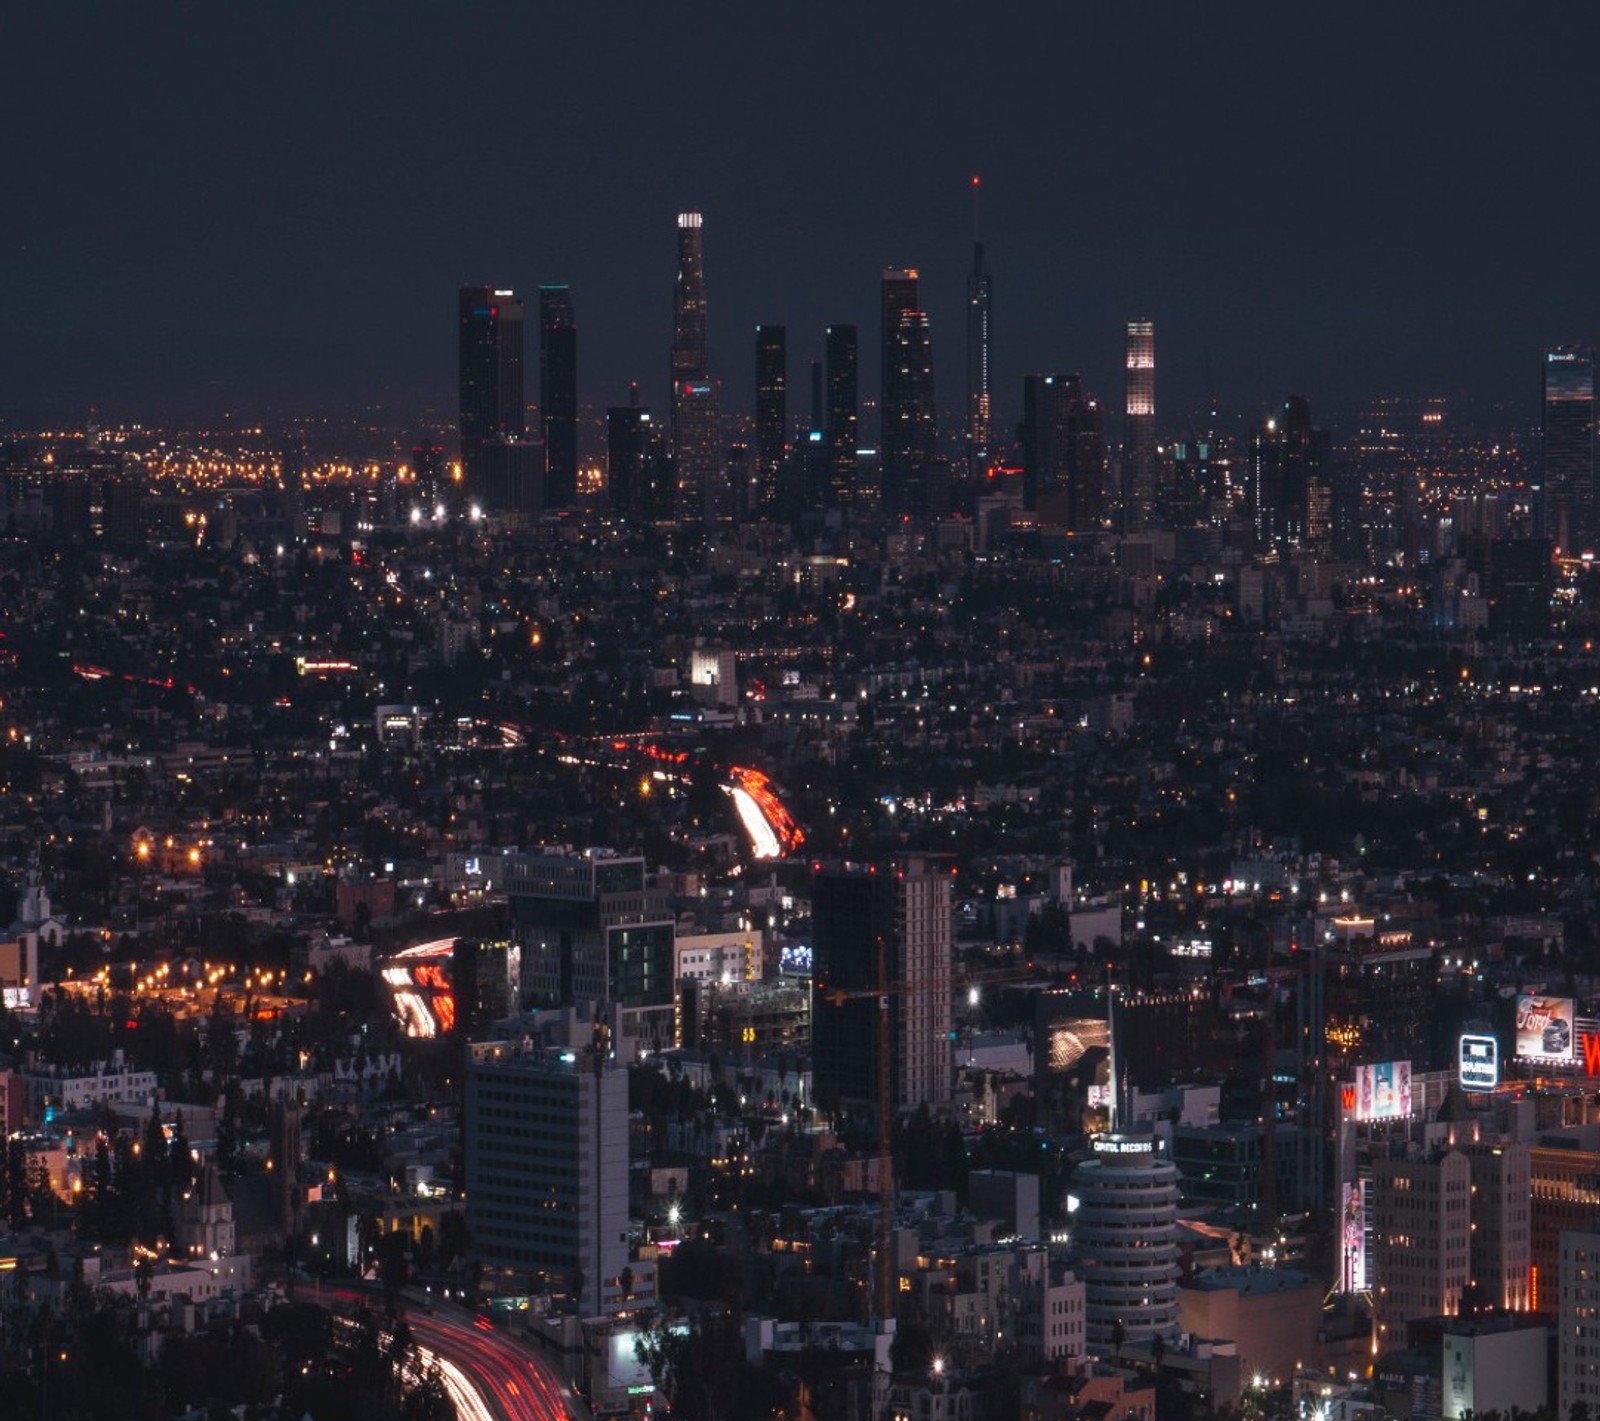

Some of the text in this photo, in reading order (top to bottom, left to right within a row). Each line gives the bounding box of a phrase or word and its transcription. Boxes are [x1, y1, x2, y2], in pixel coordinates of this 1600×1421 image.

[1516, 1000, 1554, 1030] Ford
[1581, 1031, 1600, 1080] W
[1343, 1087, 1355, 1109] W
